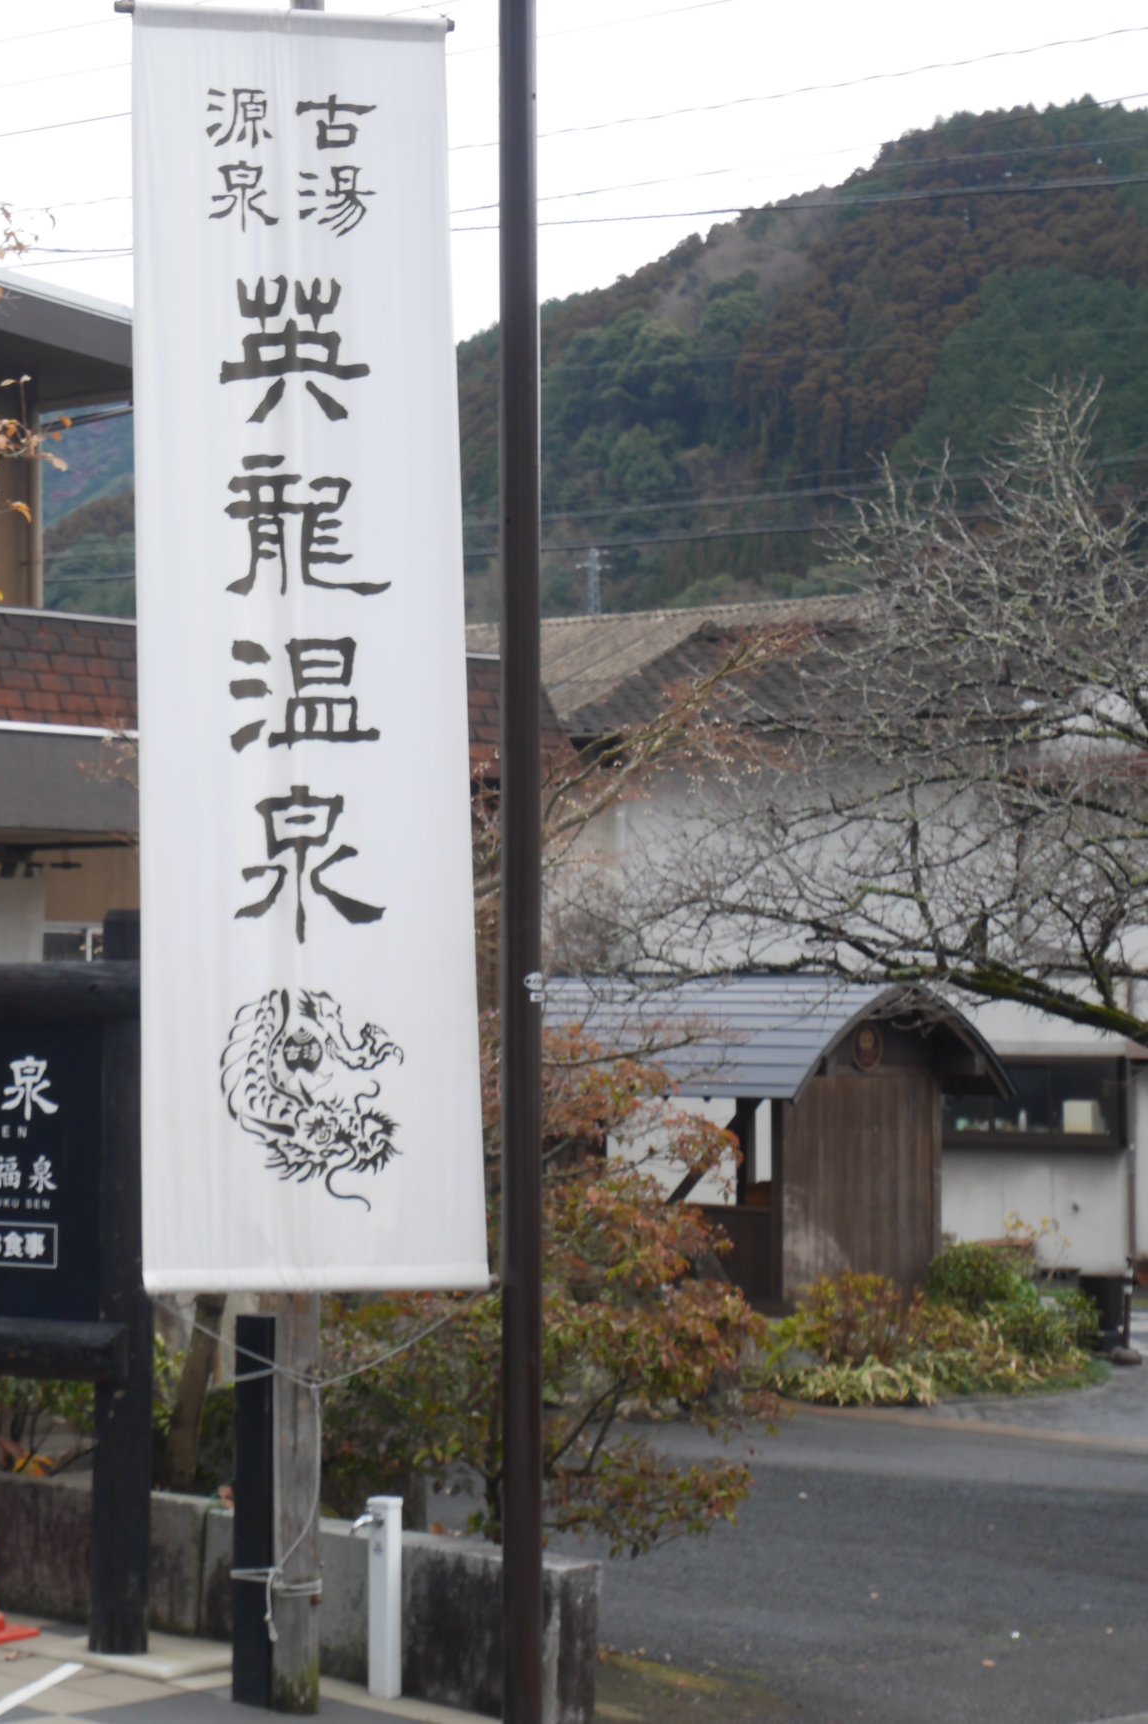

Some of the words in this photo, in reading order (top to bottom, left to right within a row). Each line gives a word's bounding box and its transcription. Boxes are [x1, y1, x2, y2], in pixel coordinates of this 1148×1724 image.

[205, 88, 278, 232] 源泉
[296, 94, 377, 238] 古湯
[219, 274, 392, 944] 英龍温泉
[25, 1198, 51, 1210] SEN
